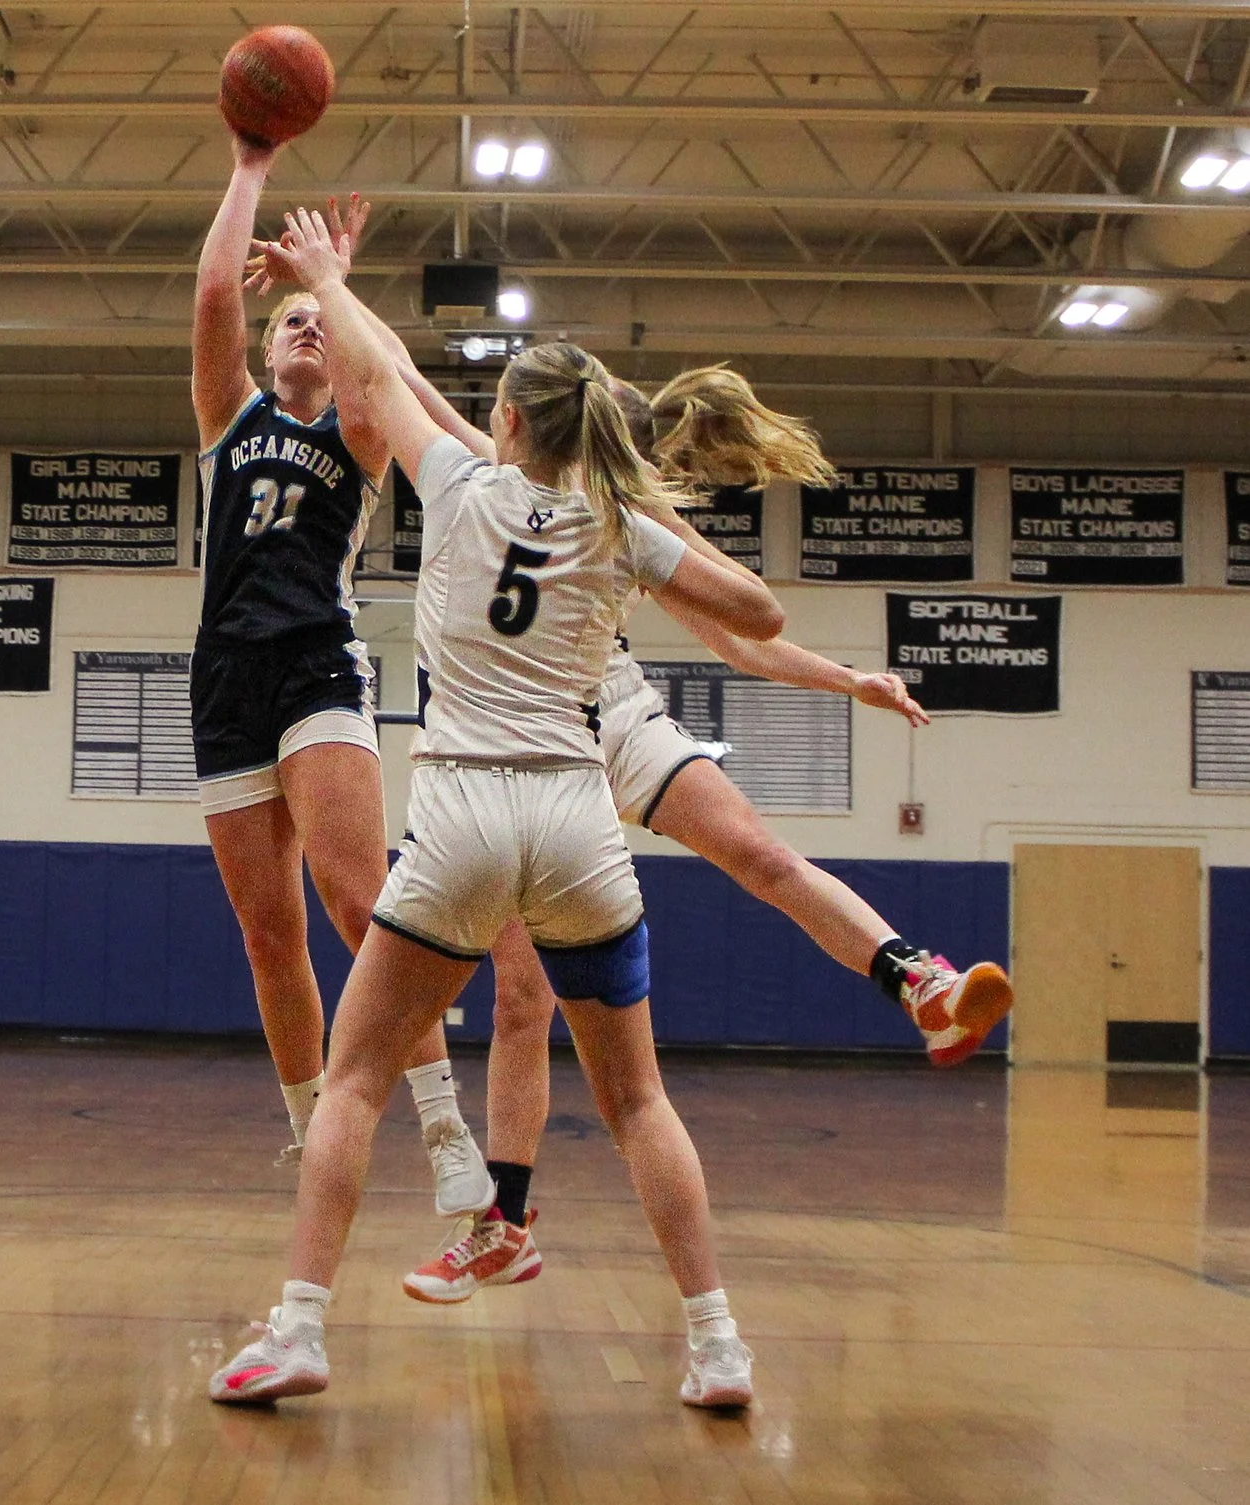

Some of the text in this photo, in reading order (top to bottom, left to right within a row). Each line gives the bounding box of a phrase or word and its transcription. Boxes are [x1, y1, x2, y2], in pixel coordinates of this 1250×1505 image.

[30, 459, 161, 478] GIRLS SKIING
[231, 435, 345, 490] OCEANSIDE
[57, 481, 132, 500] MAINE
[885, 472, 959, 491] TENNIS
[1012, 474, 1181, 493] BOYS LACROSSE
[21, 503, 168, 522] STATE CHAMPIONS
[849, 495, 926, 513] MAINE
[1060, 498, 1134, 516] MAINE
[812, 518, 963, 536] STATE CHAMPIONS
[1019, 519, 1175, 538] STATE CHAMPIONS
[488, 542, 551, 636] 5
[908, 601, 1038, 621] SOFTBALL
[939, 624, 1009, 643] MAINE
[96, 652, 163, 665] Yarmouth
[899, 645, 1049, 666] STATE CHAMPIONS
